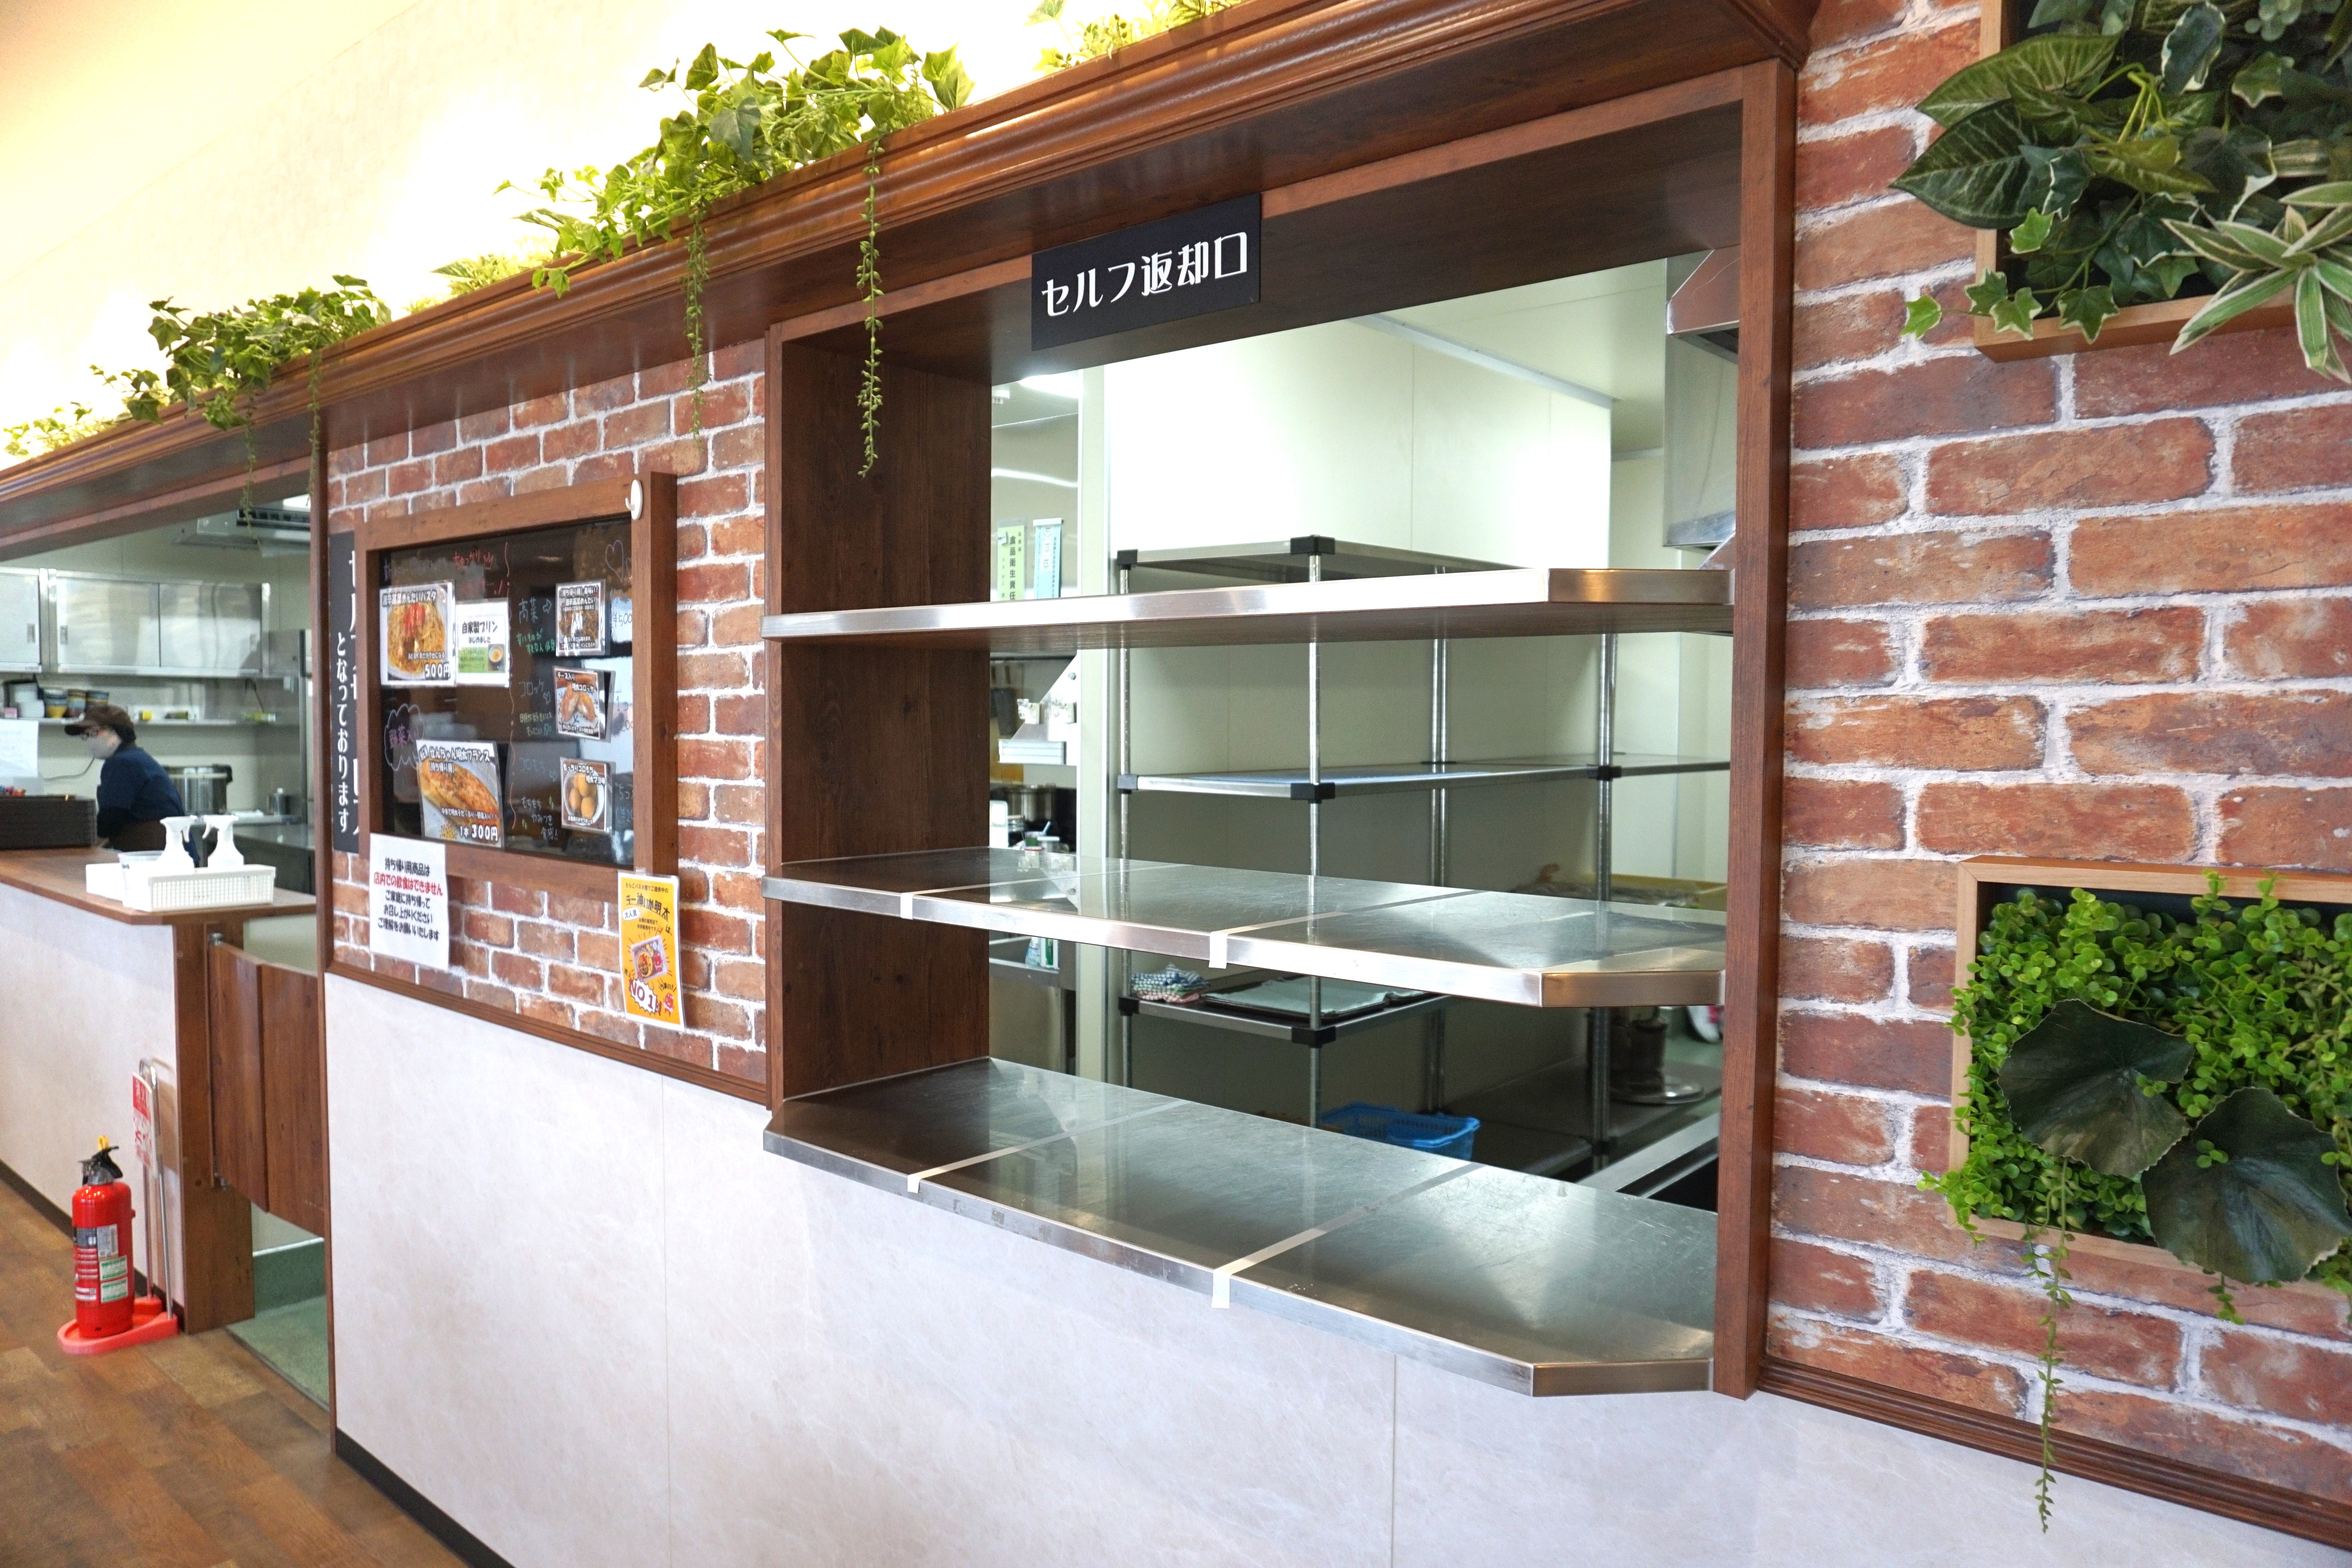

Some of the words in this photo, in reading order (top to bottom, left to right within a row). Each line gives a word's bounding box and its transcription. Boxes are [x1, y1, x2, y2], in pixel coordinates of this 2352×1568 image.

[1041, 232, 1247, 317] セルフ返却口
[519, 597, 538, 624] 高菜
[462, 621, 497, 634] 自家製プリン
[425, 661, 450, 679] 500円
[557, 671, 575, 681] チーズ入り
[572, 682, 594, 693] 明太コロッケ
[335, 632, 350, 834] となっております
[429, 746, 490, 762] せんちゃん明太フランス
[563, 764, 593, 773] もっちりコロもち
[585, 775, 606, 784] 明太マヨ味
[521, 796, 541, 810] もちもち
[531, 813, 553, 826] やみつき
[472, 824, 498, 842] 300円
[385, 857, 430, 877] 持ち帰り用商品は
[374, 871, 443, 897] 店内での飲食はできません
[385, 890, 430, 909] ご家庭に持ち帰って
[383, 904, 433, 924] お召し上がりください
[624, 908, 637, 920] 大人気
[378, 917, 439, 942] ご理解をお願いいたします
[629, 978, 645, 1001] NO
